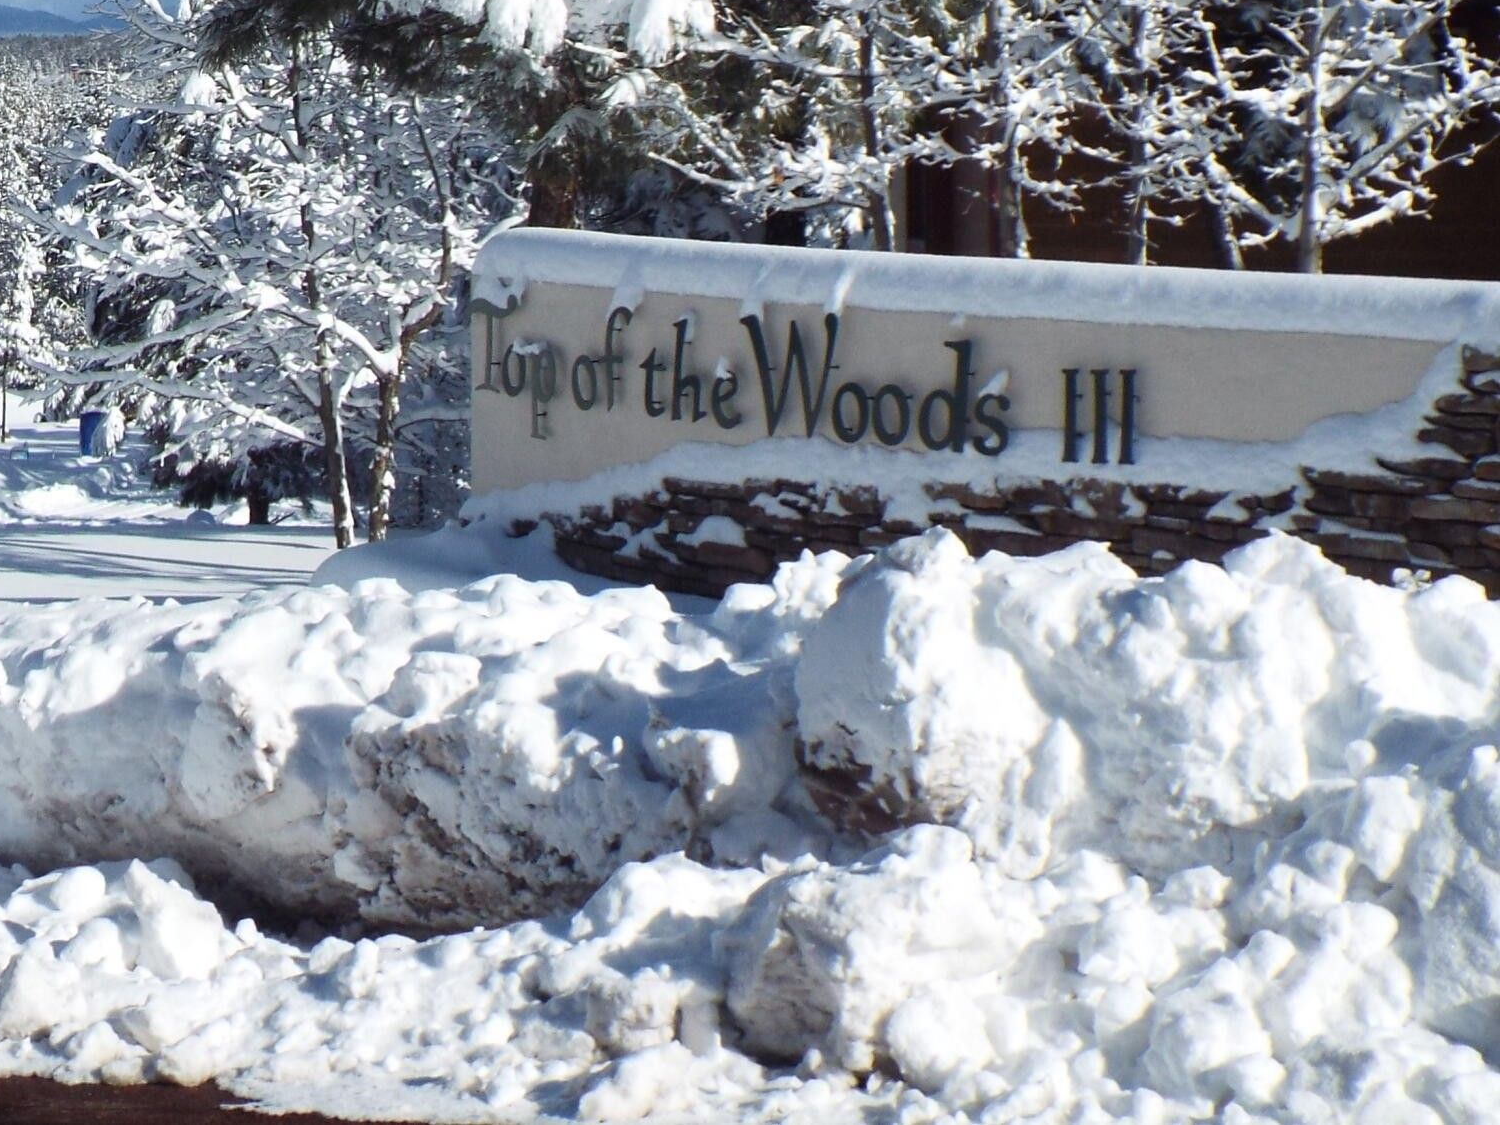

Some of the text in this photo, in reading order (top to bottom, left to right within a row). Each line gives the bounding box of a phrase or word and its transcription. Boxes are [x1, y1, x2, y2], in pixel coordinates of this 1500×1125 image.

[470, 280, 1137, 464] Top of the Woods III
